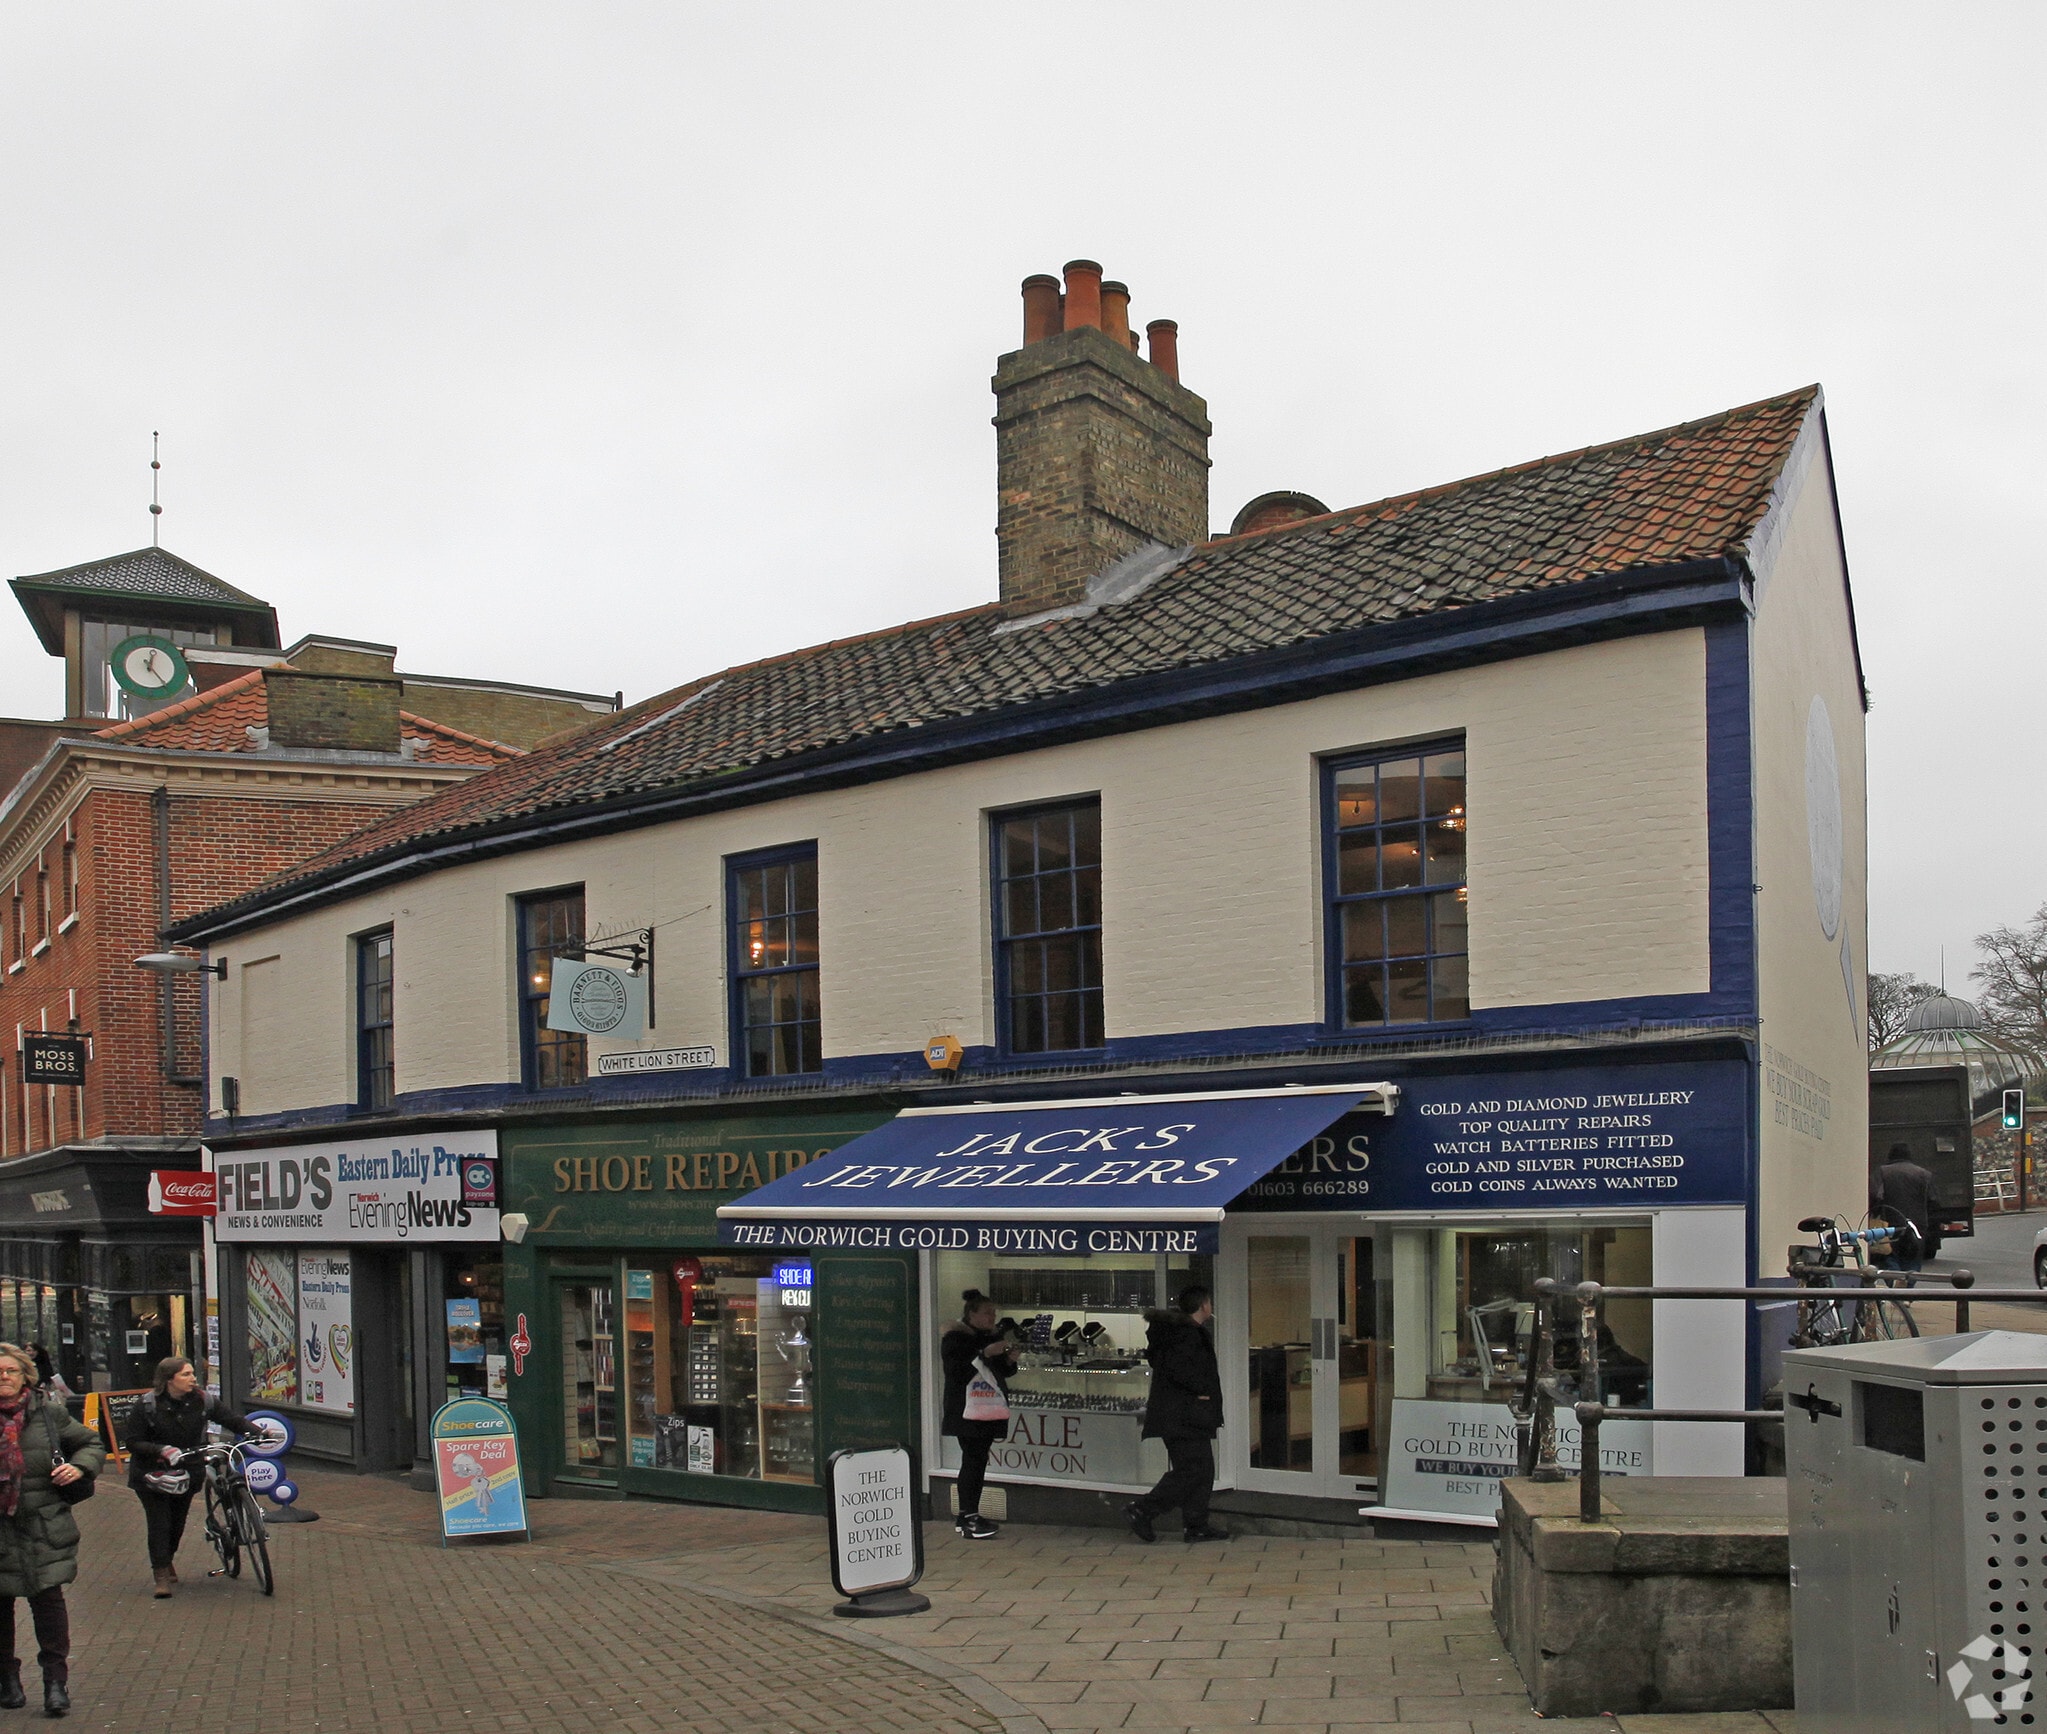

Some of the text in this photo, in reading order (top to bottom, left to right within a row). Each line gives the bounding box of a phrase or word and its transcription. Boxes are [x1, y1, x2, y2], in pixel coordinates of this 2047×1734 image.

[573, 971, 602, 1003] BARNETT
[35, 1050, 74, 1061] MOSS
[602, 1051, 710, 1070] WHITE LION STREET
[931, 1048, 945, 1058] ADT
[1420, 1090, 1695, 1115] GOLD AND DIAMOND JEWELLERY
[1459, 1114, 1652, 1135] TOP QUALITY REPAIRS
[654, 1129, 725, 1148] Traditional
[1434, 1134, 1674, 1154] WATCH BATTERIES FITTED
[337, 1153, 389, 1182] Eastern
[391, 1148, 430, 1185] Daily
[802, 1157, 1238, 1189] JEWELLERS
[1425, 1155, 1684, 1174] GOLD AND SILVER PURCHASED
[554, 1155, 653, 1193] SHOE
[165, 1181, 215, 1198] Coca-Cola
[218, 1156, 332, 1211] FIELD'S
[1248, 1180, 1369, 1195] 01603 666289
[1431, 1175, 1678, 1193] GOLD COINS ALWAYS WANTED
[357, 1192, 380, 1202] Norwich
[465, 1191, 494, 1199] payzone
[228, 1214, 323, 1228] NEWS & CONVENIENCE
[733, 1225, 1198, 1252] THE NORWICH GOLD BUYING CENTRE
[780, 1268, 802, 1285] SHOE
[442, 1420, 504, 1431] Shoecare
[668, 1416, 685, 1429] Zips
[993, 1413, 1083, 1449] ALE
[1448, 1422, 1488, 1439] THE
[446, 1440, 506, 1453] Spare Key
[480, 1450, 506, 1460] Deal
[1404, 1438, 1461, 1456] GOLD
[1555, 1447, 1642, 1467] CETRE
[986, 1449, 1088, 1474] NOW ON
[1421, 1461, 1518, 1477] WE BUY YOUR
[858, 1470, 887, 1485] THE
[841, 1487, 904, 1507] NORWICH
[1446, 1481, 1483, 1495] BEST
[853, 1507, 894, 1524] GOLD
[848, 1525, 901, 1545] BUYING
[847, 1543, 902, 1564] CENTRE
